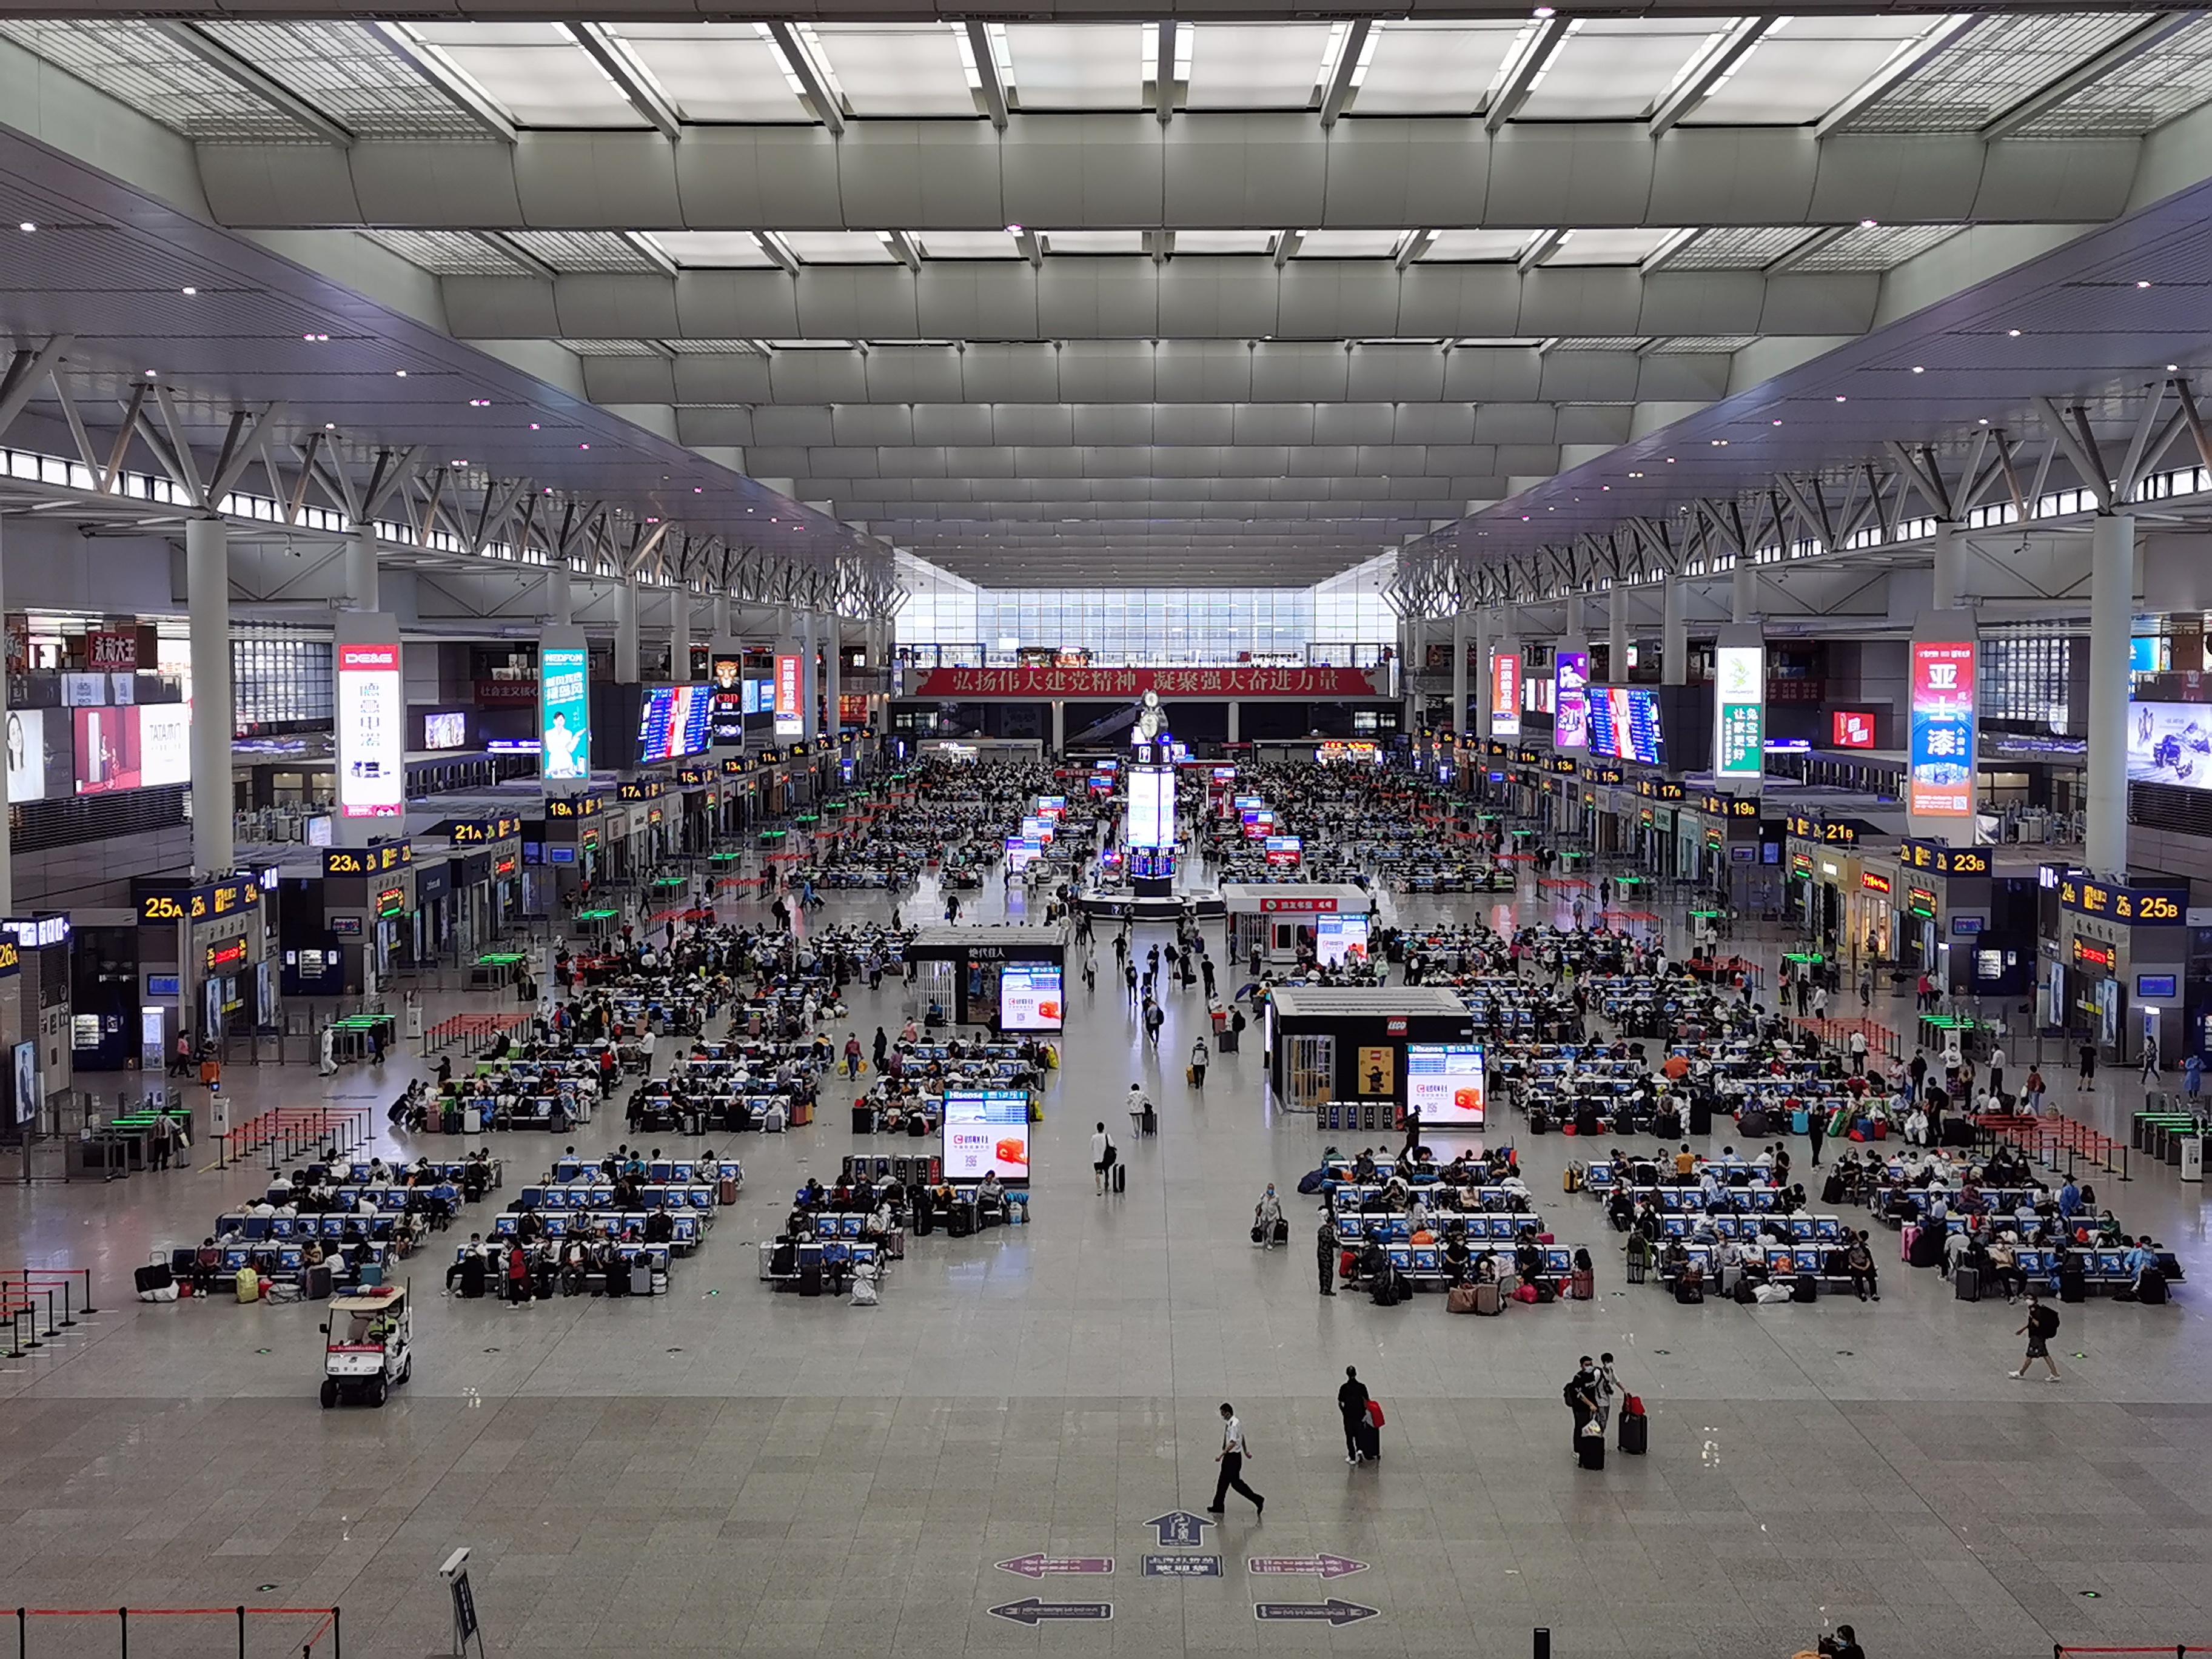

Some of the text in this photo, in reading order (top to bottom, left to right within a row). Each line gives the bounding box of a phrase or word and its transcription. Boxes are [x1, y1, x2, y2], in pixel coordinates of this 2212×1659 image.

[95, 637, 135, 662] 永和大王
[545, 654, 583, 662] NEDFON
[953, 670, 1338, 691] 弘扬伟大建党精神 凝聚强大奋进力量
[716, 693, 739, 703] CBD
[1927, 663, 1957, 756] 亚士漆
[762, 753, 777, 762] 11A
[725, 762, 741, 771] 13A
[681, 772, 699, 783] 15A
[622, 786, 642, 798] 17A
[1661, 785, 1681, 797] 17B
[550, 802, 572, 816] 19A
[1733, 802, 1755, 815] 19B
[455, 825, 482, 840] 21A
[1826, 825, 1854, 839] 21B
[329, 855, 360, 871] 23A
[1954, 854, 1985, 871] 23B
[146, 898, 183, 917] 25A
[2140, 897, 2178, 917] 25B
[1387, 1021, 1407, 1030] LEGO
